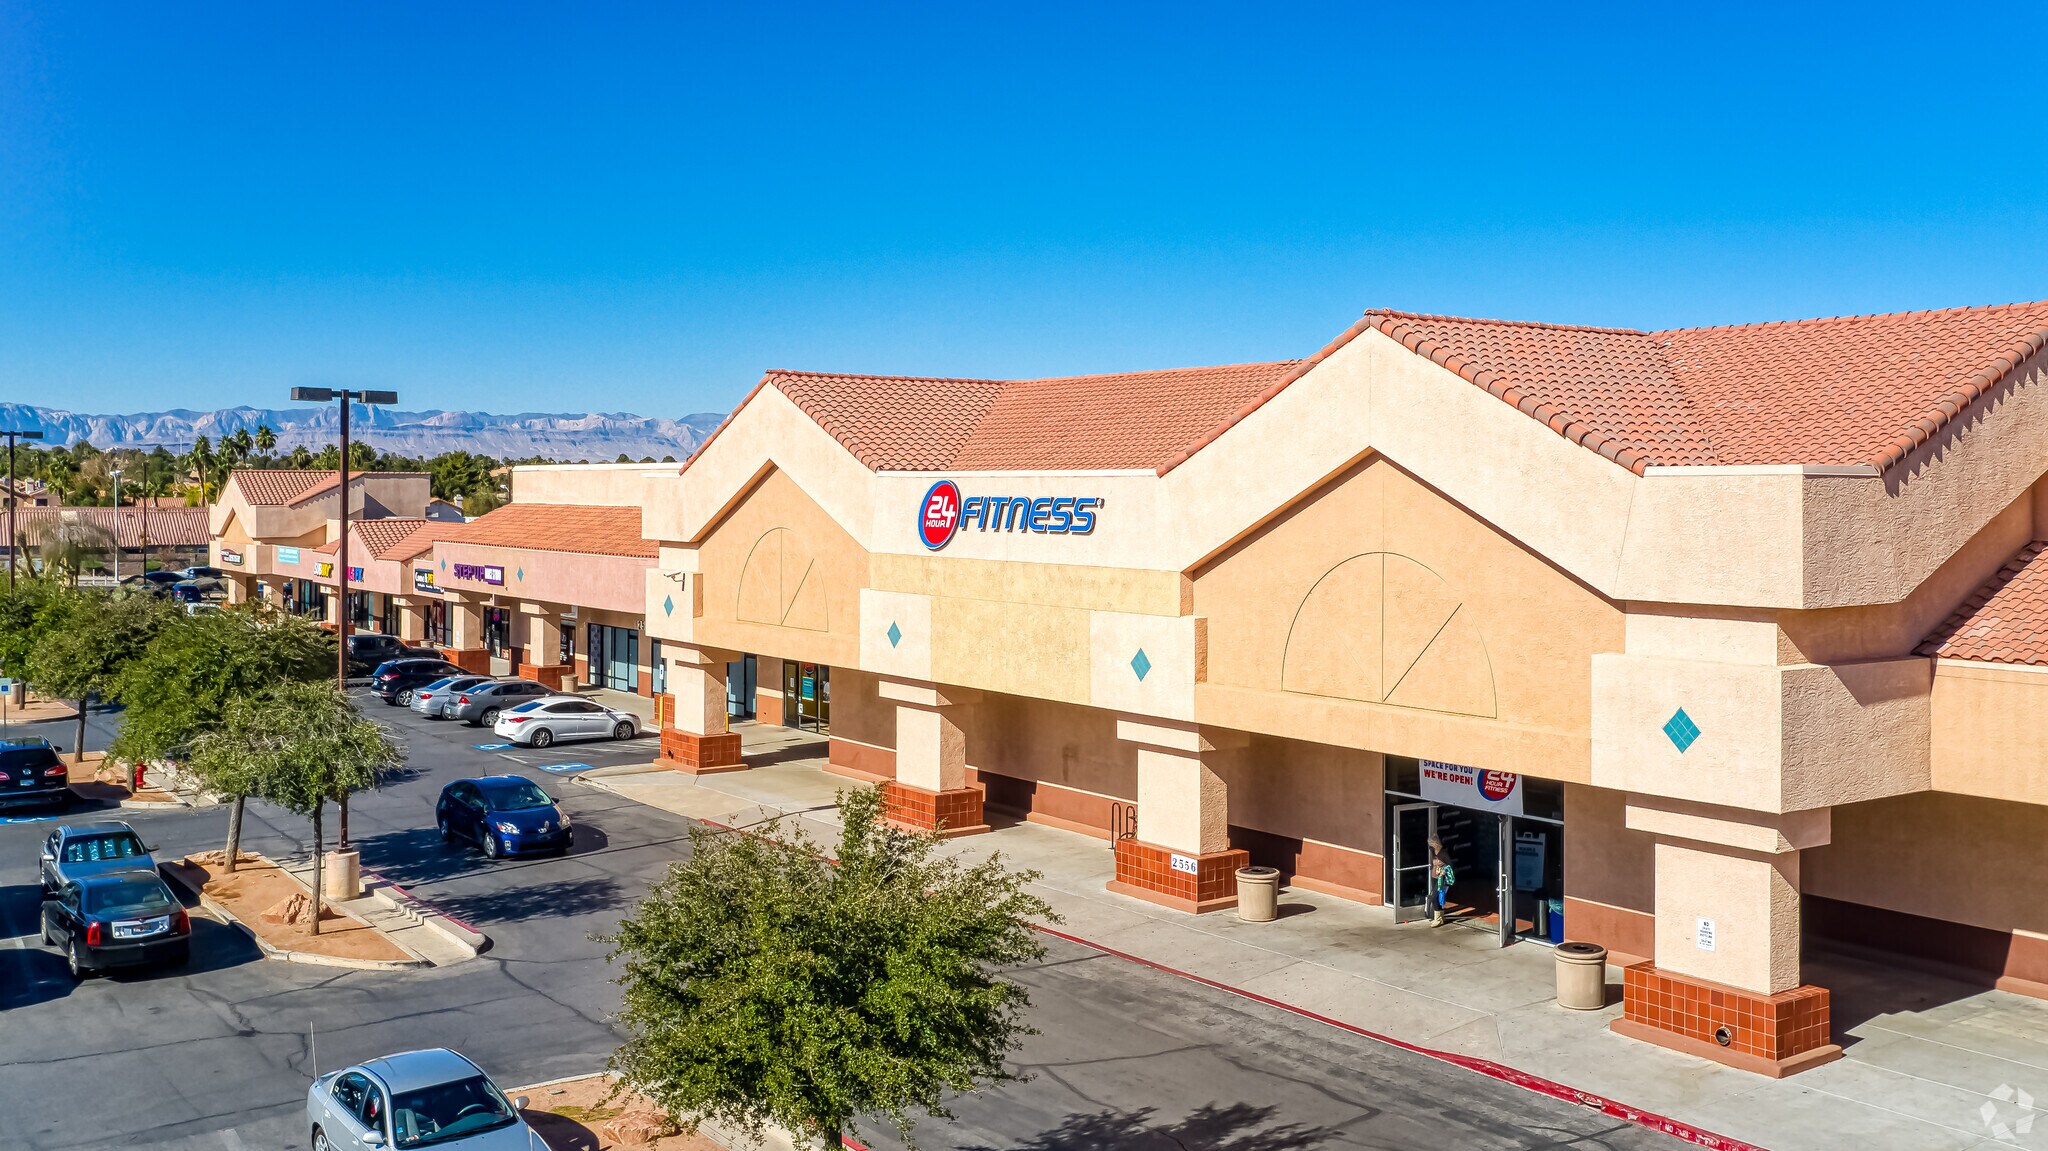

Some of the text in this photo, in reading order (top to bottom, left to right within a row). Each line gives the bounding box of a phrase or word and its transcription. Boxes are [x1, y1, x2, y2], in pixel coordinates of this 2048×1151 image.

[927, 496, 956, 528] 24
[959, 496, 1098, 533] FITNESS
[926, 519, 945, 528] HOUR
[453, 563, 472, 579] STEP
[473, 566, 485, 580] UP
[1423, 760, 1473, 774] SPACE FOR YOU
[1423, 769, 1473, 785] WE'RE OPEN!
[1487, 770, 1514, 788] 24
[1484, 786, 1509, 794] FITNESS
[1172, 858, 1196, 872] 2556
